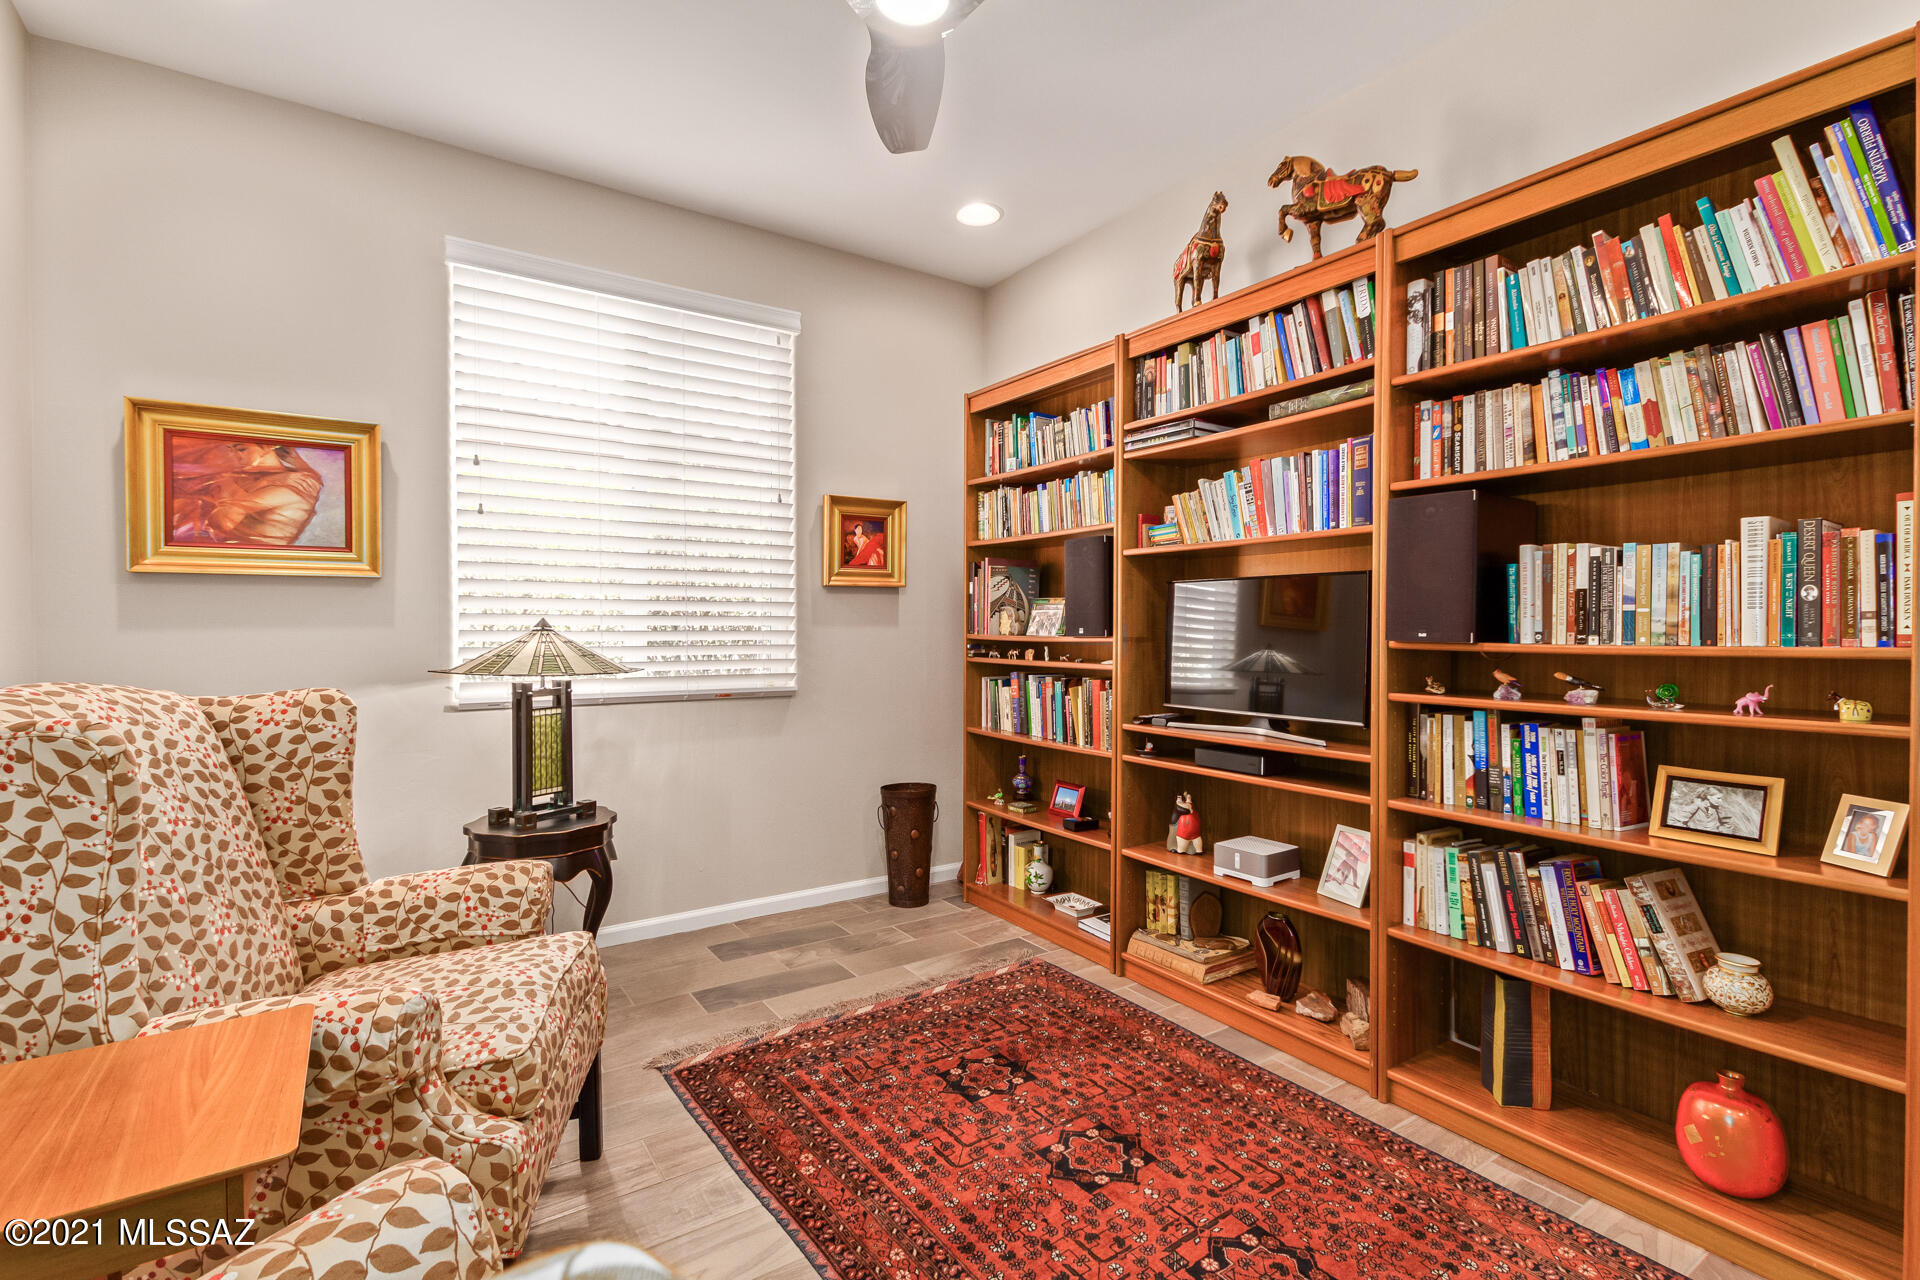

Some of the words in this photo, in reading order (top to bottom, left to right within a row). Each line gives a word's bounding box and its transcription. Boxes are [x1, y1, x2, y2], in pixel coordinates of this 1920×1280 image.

[1857, 118, 1876, 149] FIERRO
[1869, 148, 1888, 188] MARTIN
[1357, 282, 1369, 313] FRIDA
[1905, 310, 1913, 324] WALK
[1747, 520, 1764, 551] STRAIGHT
[1803, 520, 1816, 550] DESERT
[1747, 566, 1764, 578] TILL
[1785, 572, 1793, 590] WEST
[1801, 552, 1816, 582] QUEEN
[1747, 581, 1764, 610] MORNING
[1600, 763, 1608, 780] Color
[1600, 781, 1608, 799] Purple
[1572, 915, 1586, 953] MOUNTAIN
[1623, 946, 1635, 970] Children
